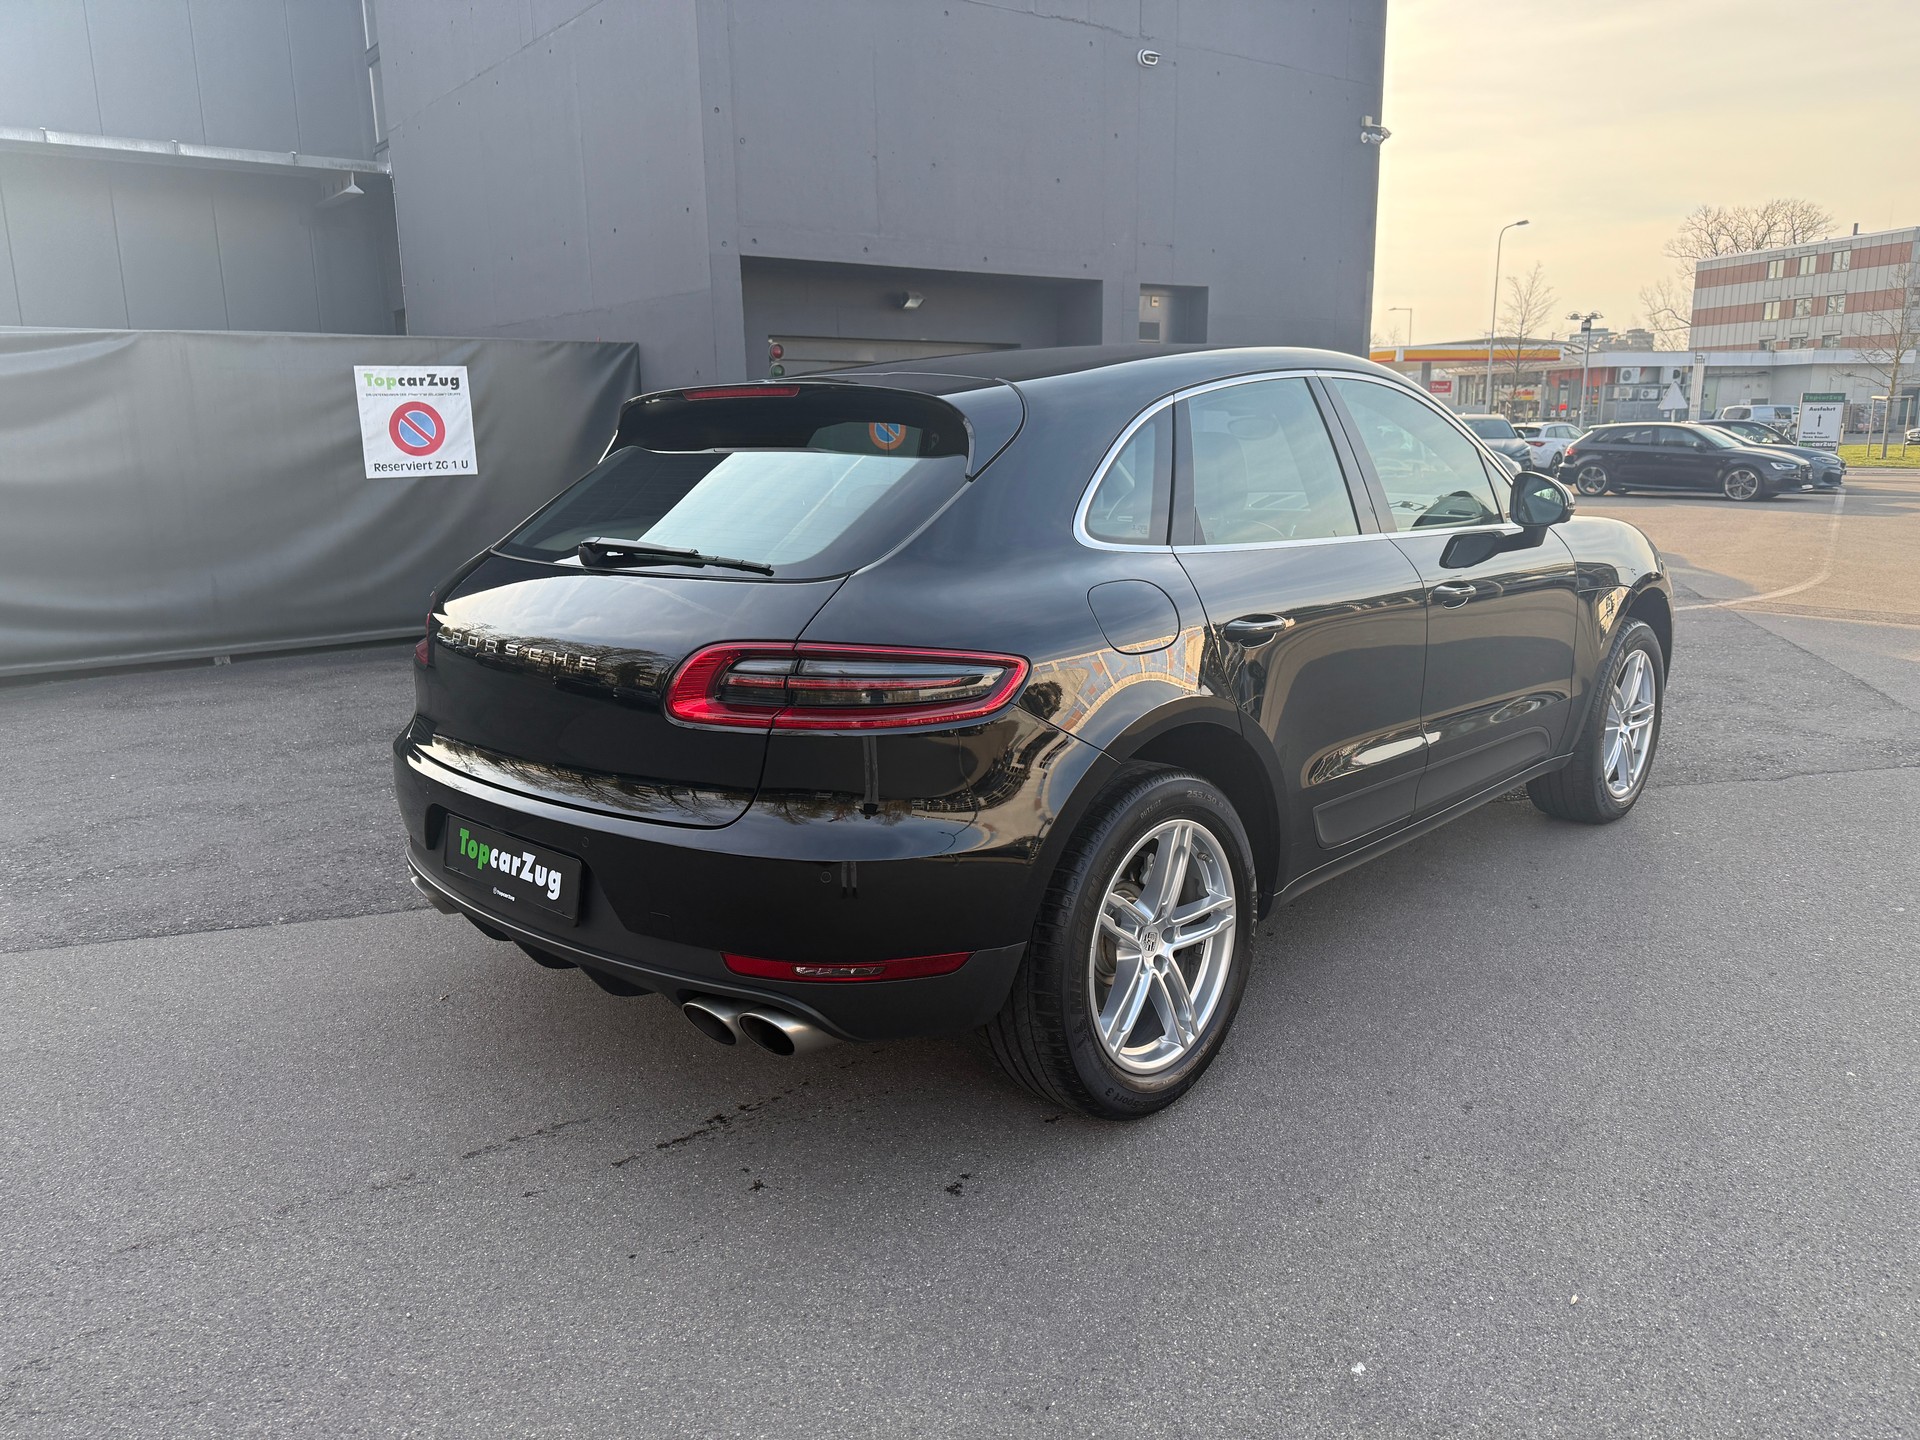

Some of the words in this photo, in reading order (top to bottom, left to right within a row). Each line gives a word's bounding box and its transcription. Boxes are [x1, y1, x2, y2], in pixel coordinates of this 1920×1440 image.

[364, 373, 460, 390] TopcarZug
[373, 460, 433, 472] Reserviert
[436, 460, 449, 470] ZG
[451, 460, 458, 470] 1
[461, 459, 469, 469] U
[452, 631, 598, 671] PORSCHE
[1187, 790, 1217, 804] 255/50
[459, 827, 562, 901] TopcarZug
[1105, 1087, 1115, 1097] 3
